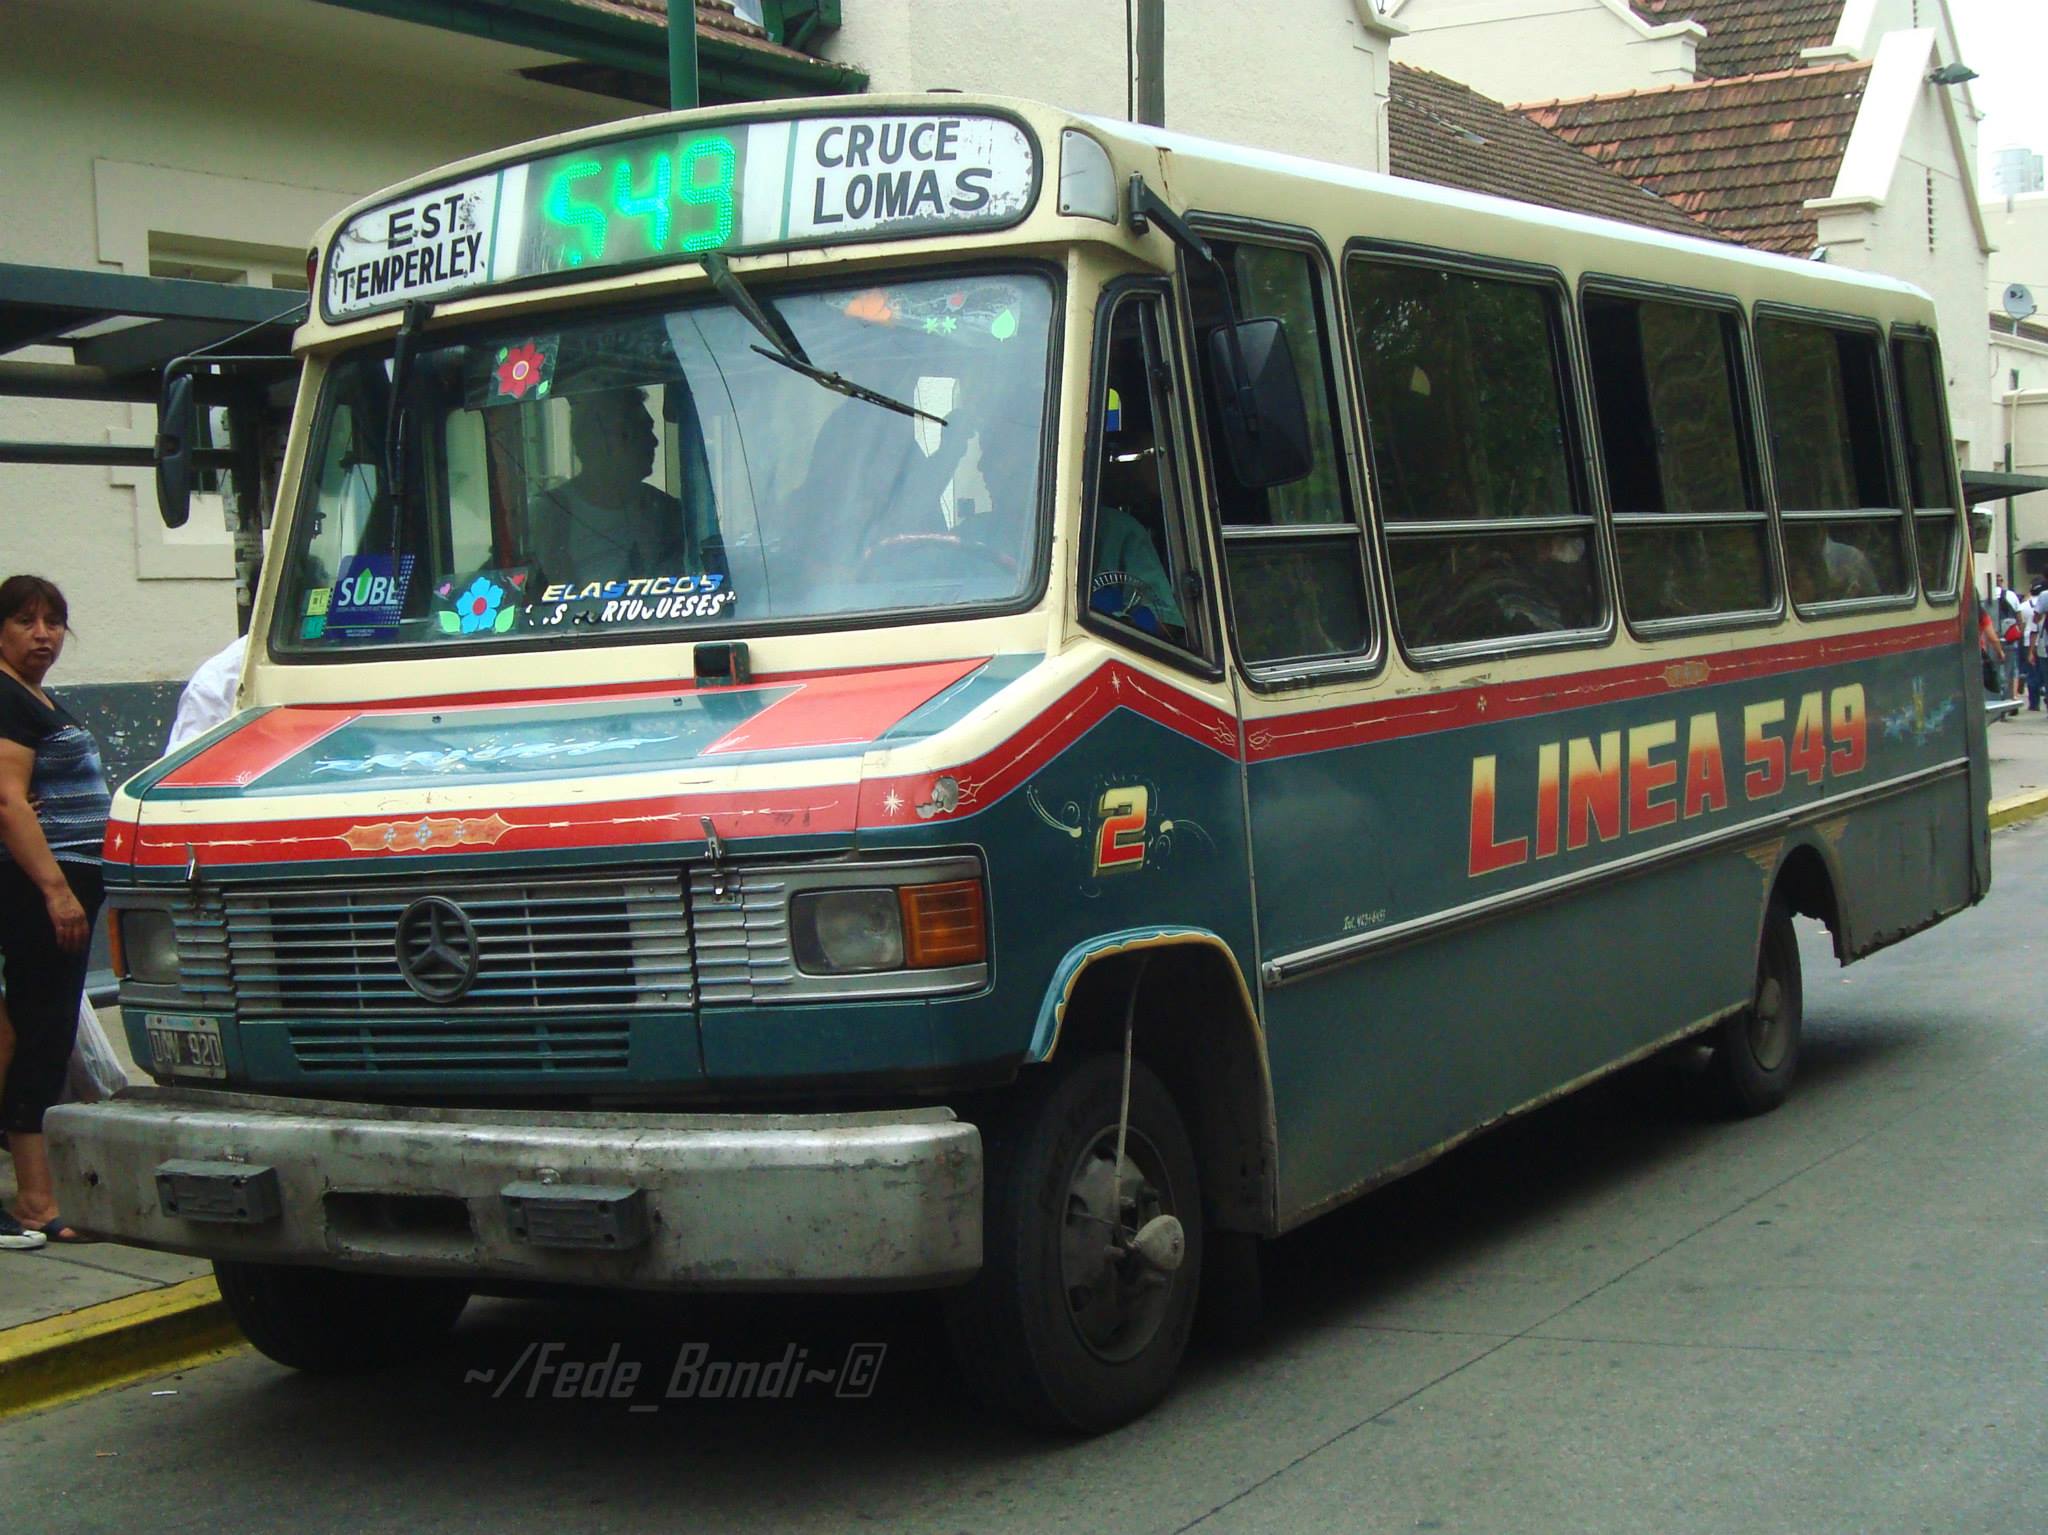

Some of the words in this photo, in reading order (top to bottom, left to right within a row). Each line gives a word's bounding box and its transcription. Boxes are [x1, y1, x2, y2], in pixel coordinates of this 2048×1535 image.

[816, 120, 960, 167] CRUCE
[388, 193, 466, 250] EST.
[547, 138, 736, 264] 549
[813, 167, 992, 224] LOMAS
[337, 232, 483, 304] TEMPERLEY
[1468, 711, 1728, 877] LINEA
[1743, 682, 1867, 801] 549
[1093, 785, 1148, 877] 2
[187, 1032, 221, 1067] 920
